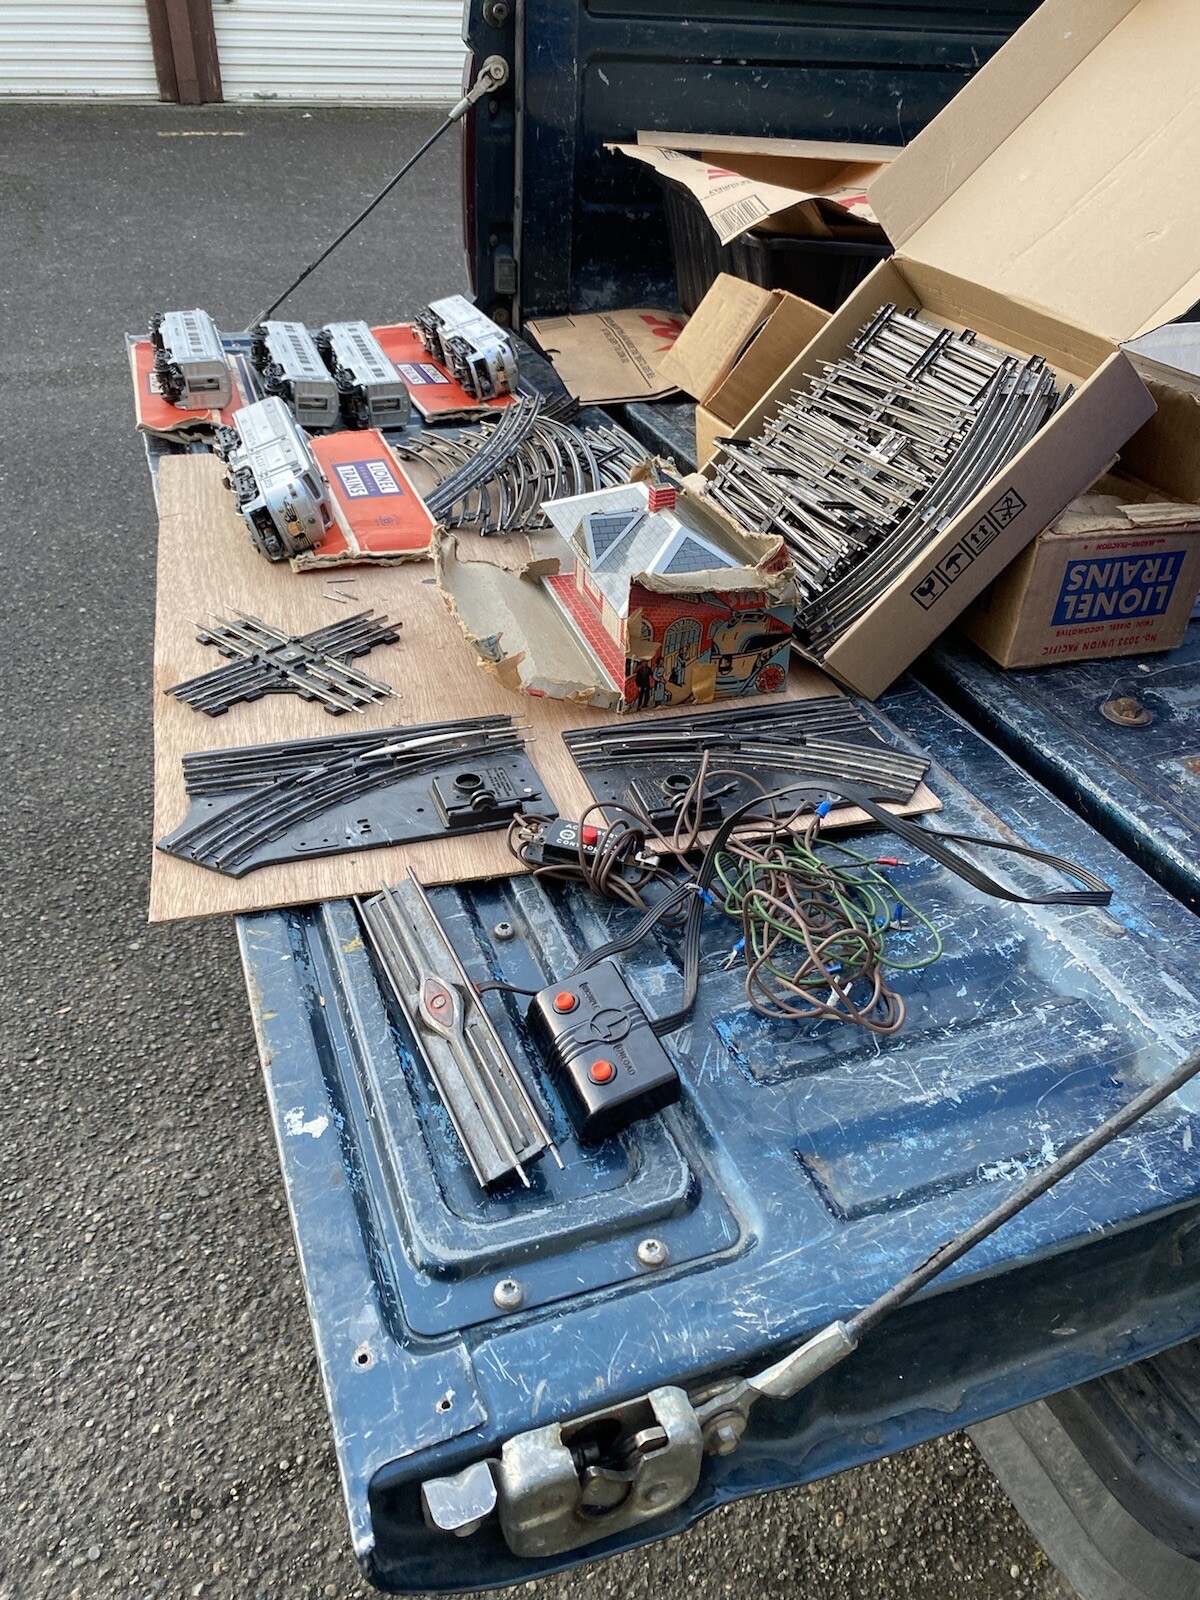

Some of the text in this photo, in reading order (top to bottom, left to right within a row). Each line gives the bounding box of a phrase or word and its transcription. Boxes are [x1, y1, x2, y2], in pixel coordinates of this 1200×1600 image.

[340, 468, 366, 494] TRAINS
[370, 464, 396, 490] LIONEL
[1066, 557, 1175, 591] TRAINS
[1063, 586, 1168, 620] LIONEL
[1056, 626, 1104, 637] LOCOMOTIVE
[1082, 639, 1114, 650] UNION
[1041, 643, 1079, 655] PACIFIC
[613, 1044, 636, 1076] UNLOAD
